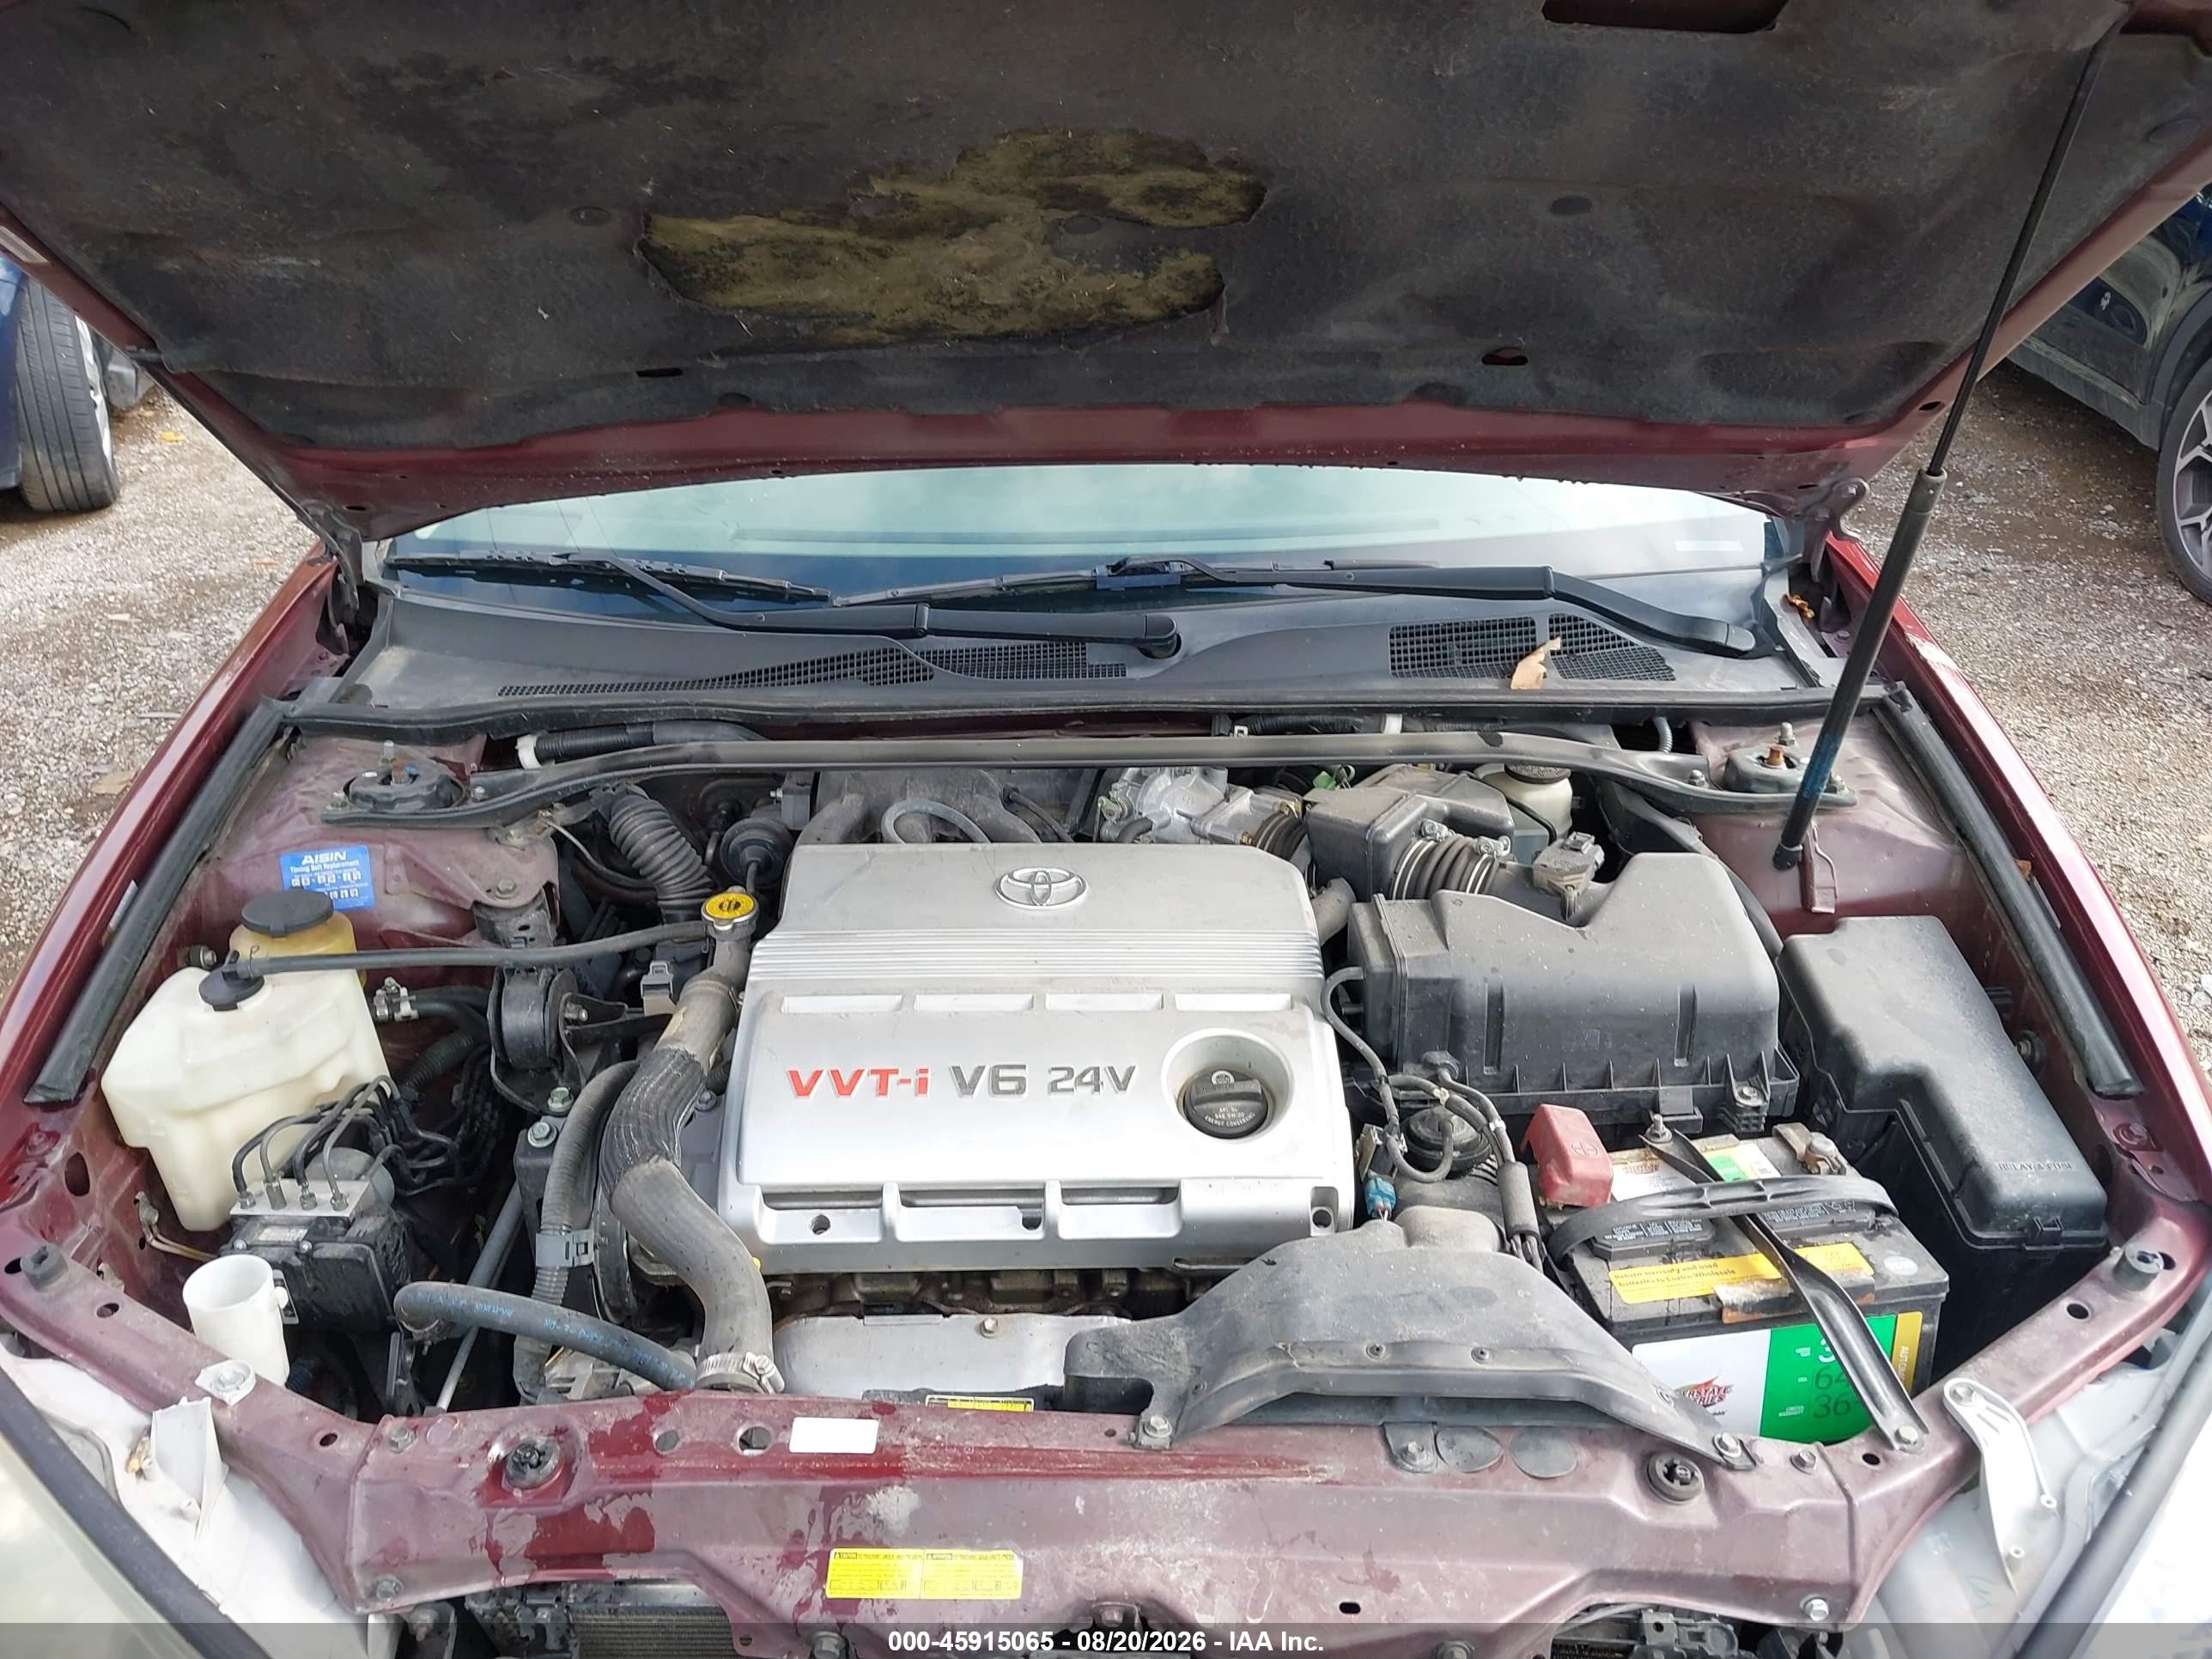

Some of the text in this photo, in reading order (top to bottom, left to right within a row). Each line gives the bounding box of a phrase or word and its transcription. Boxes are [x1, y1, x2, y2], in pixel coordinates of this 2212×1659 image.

[290, 860, 360, 873] Timing Belt Replacement
[301, 851, 347, 866] AISIN
[787, 1064, 1137, 1097] VVT-i V6 24V
[1204, 1115, 1224, 1127] ENERGY
[1619, 1278, 1656, 1286] batteries
[1693, 1268, 1736, 1278] Wholesale
[1644, 1267, 1680, 1276] warranty
[1818, 1337, 1837, 1363] 3
[1813, 1393, 1851, 1419] 36
